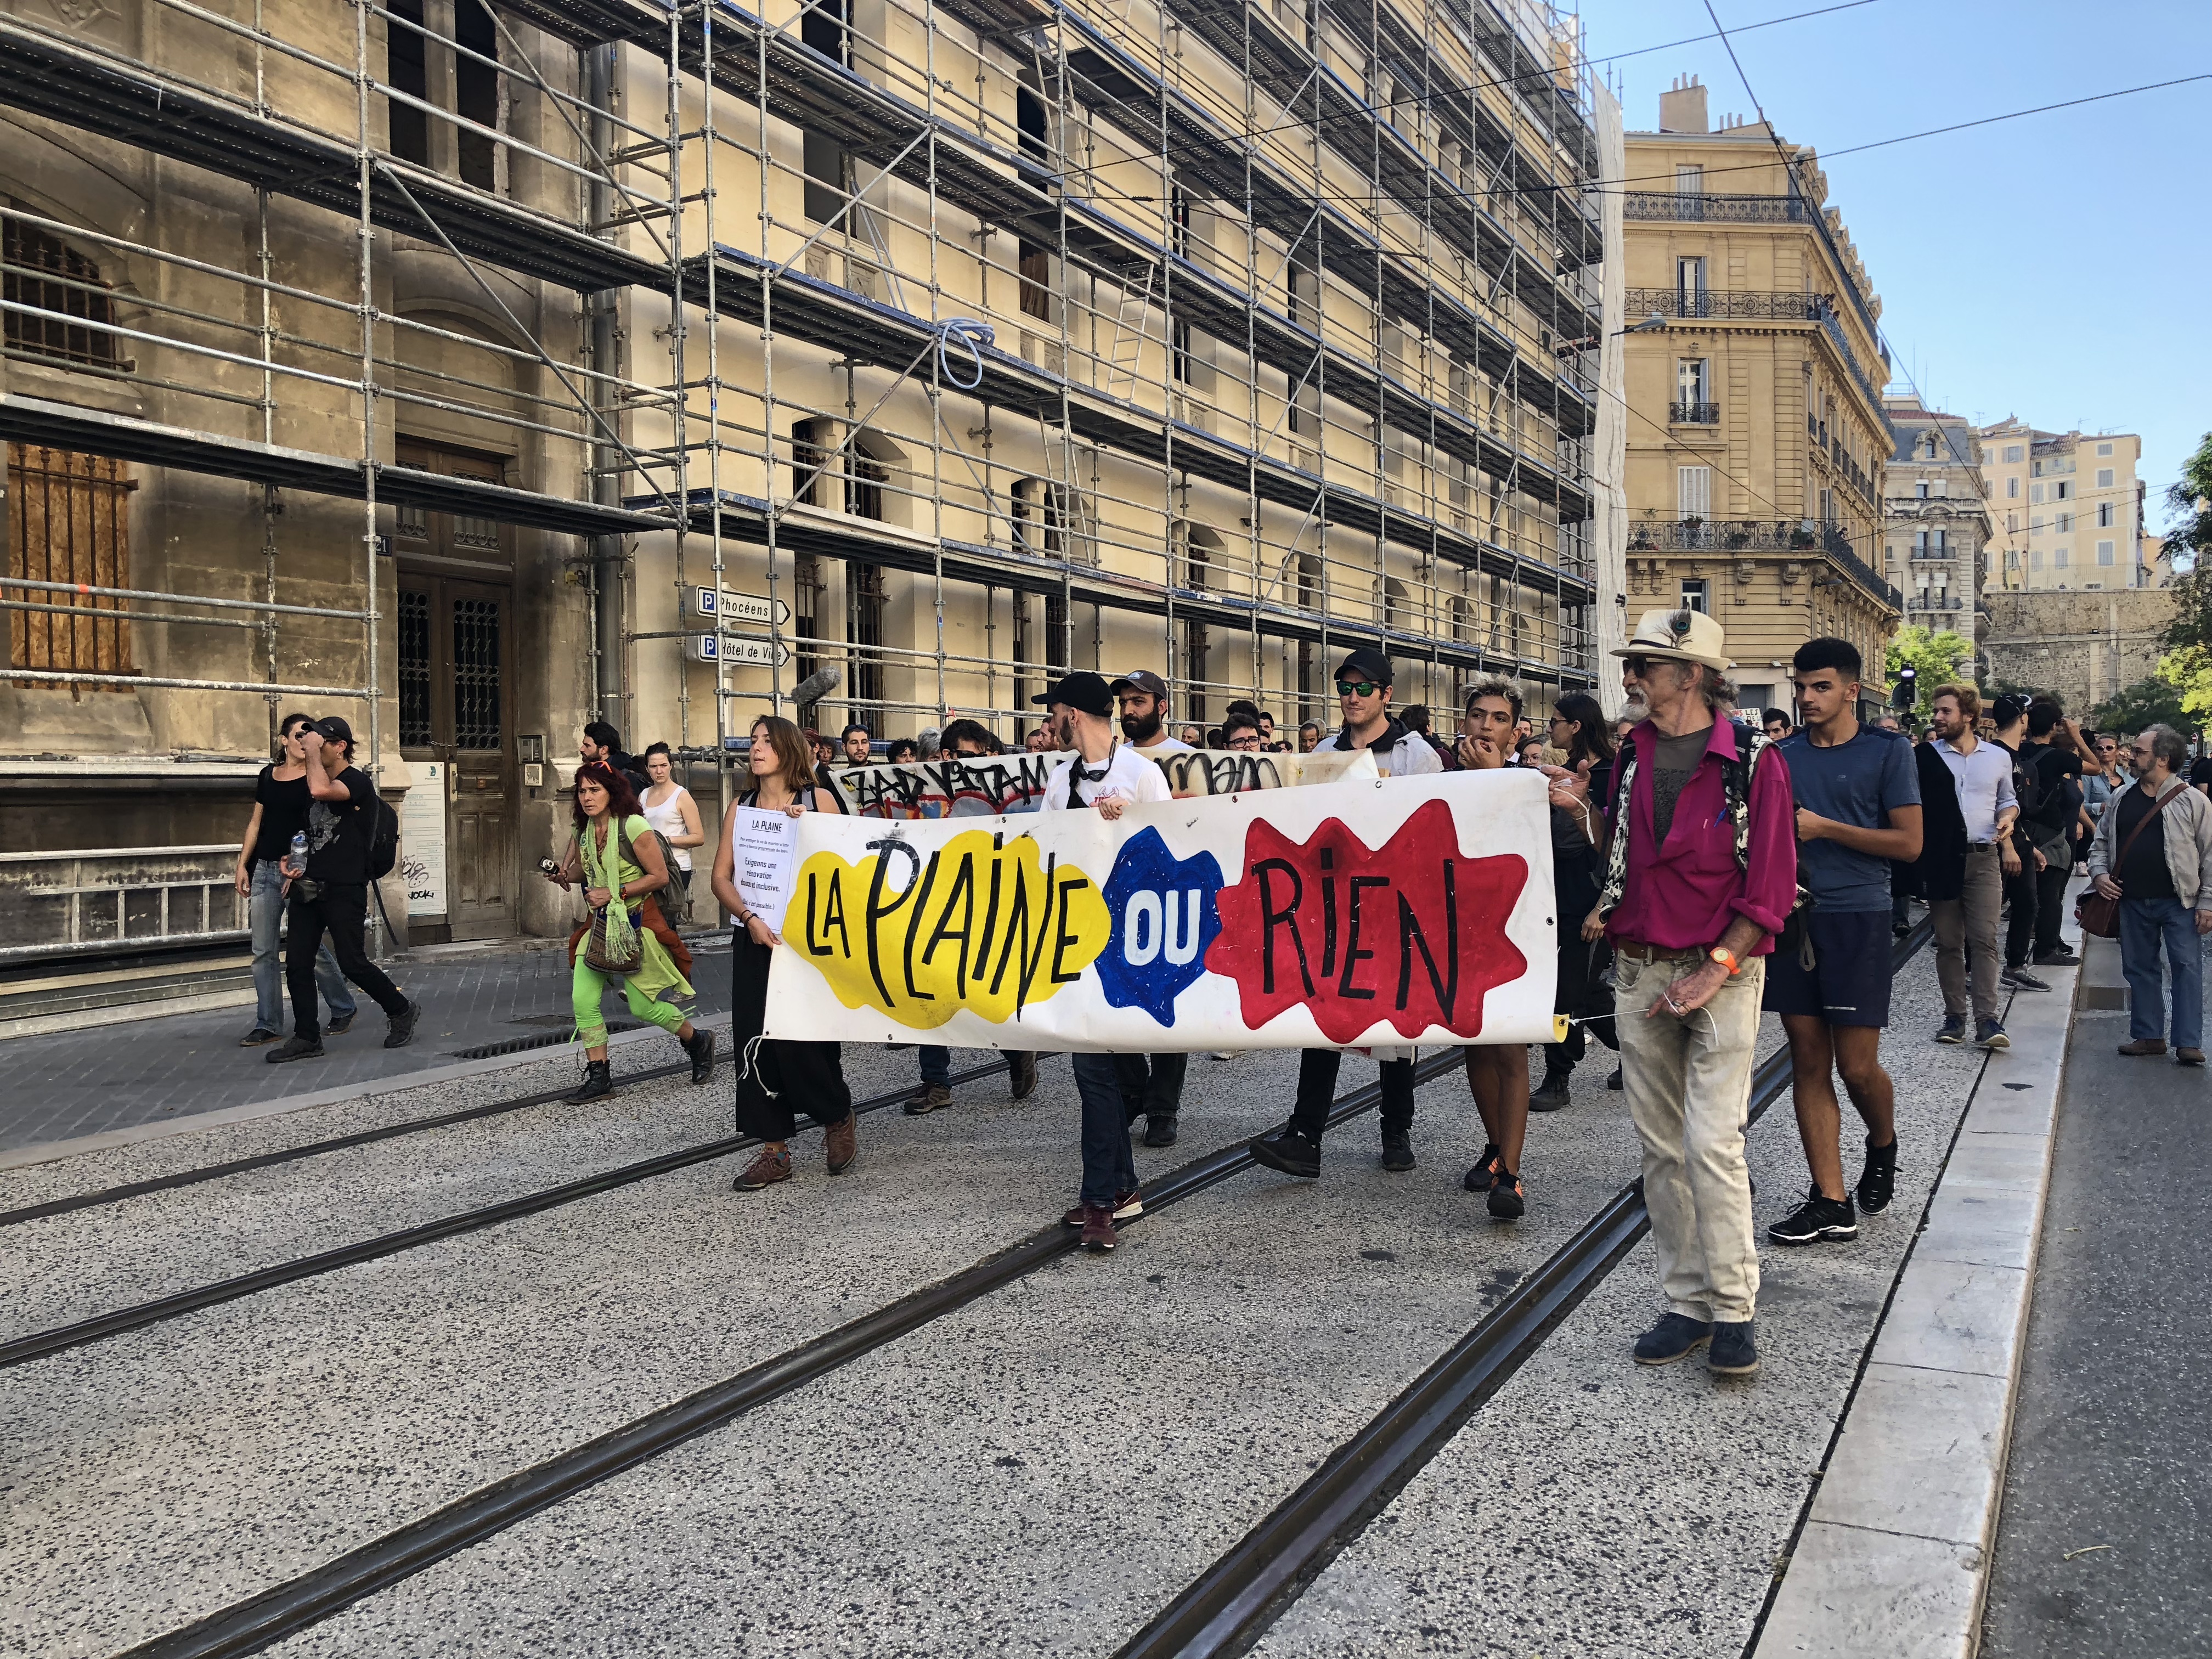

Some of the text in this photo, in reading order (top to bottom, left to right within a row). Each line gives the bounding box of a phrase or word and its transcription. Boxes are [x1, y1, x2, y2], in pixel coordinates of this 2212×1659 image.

[748, 646, 758, 658] de
[763, 647, 781, 661] Vie
[840, 767, 929, 809] ZAD
[752, 820, 783, 832] LA PLAINE
[745, 857, 767, 867] Exigeons
[747, 870, 772, 879] rénovation
[756, 882, 780, 892] inclusive.
[806, 872, 850, 959] LA
[1124, 889, 1201, 967] OU
